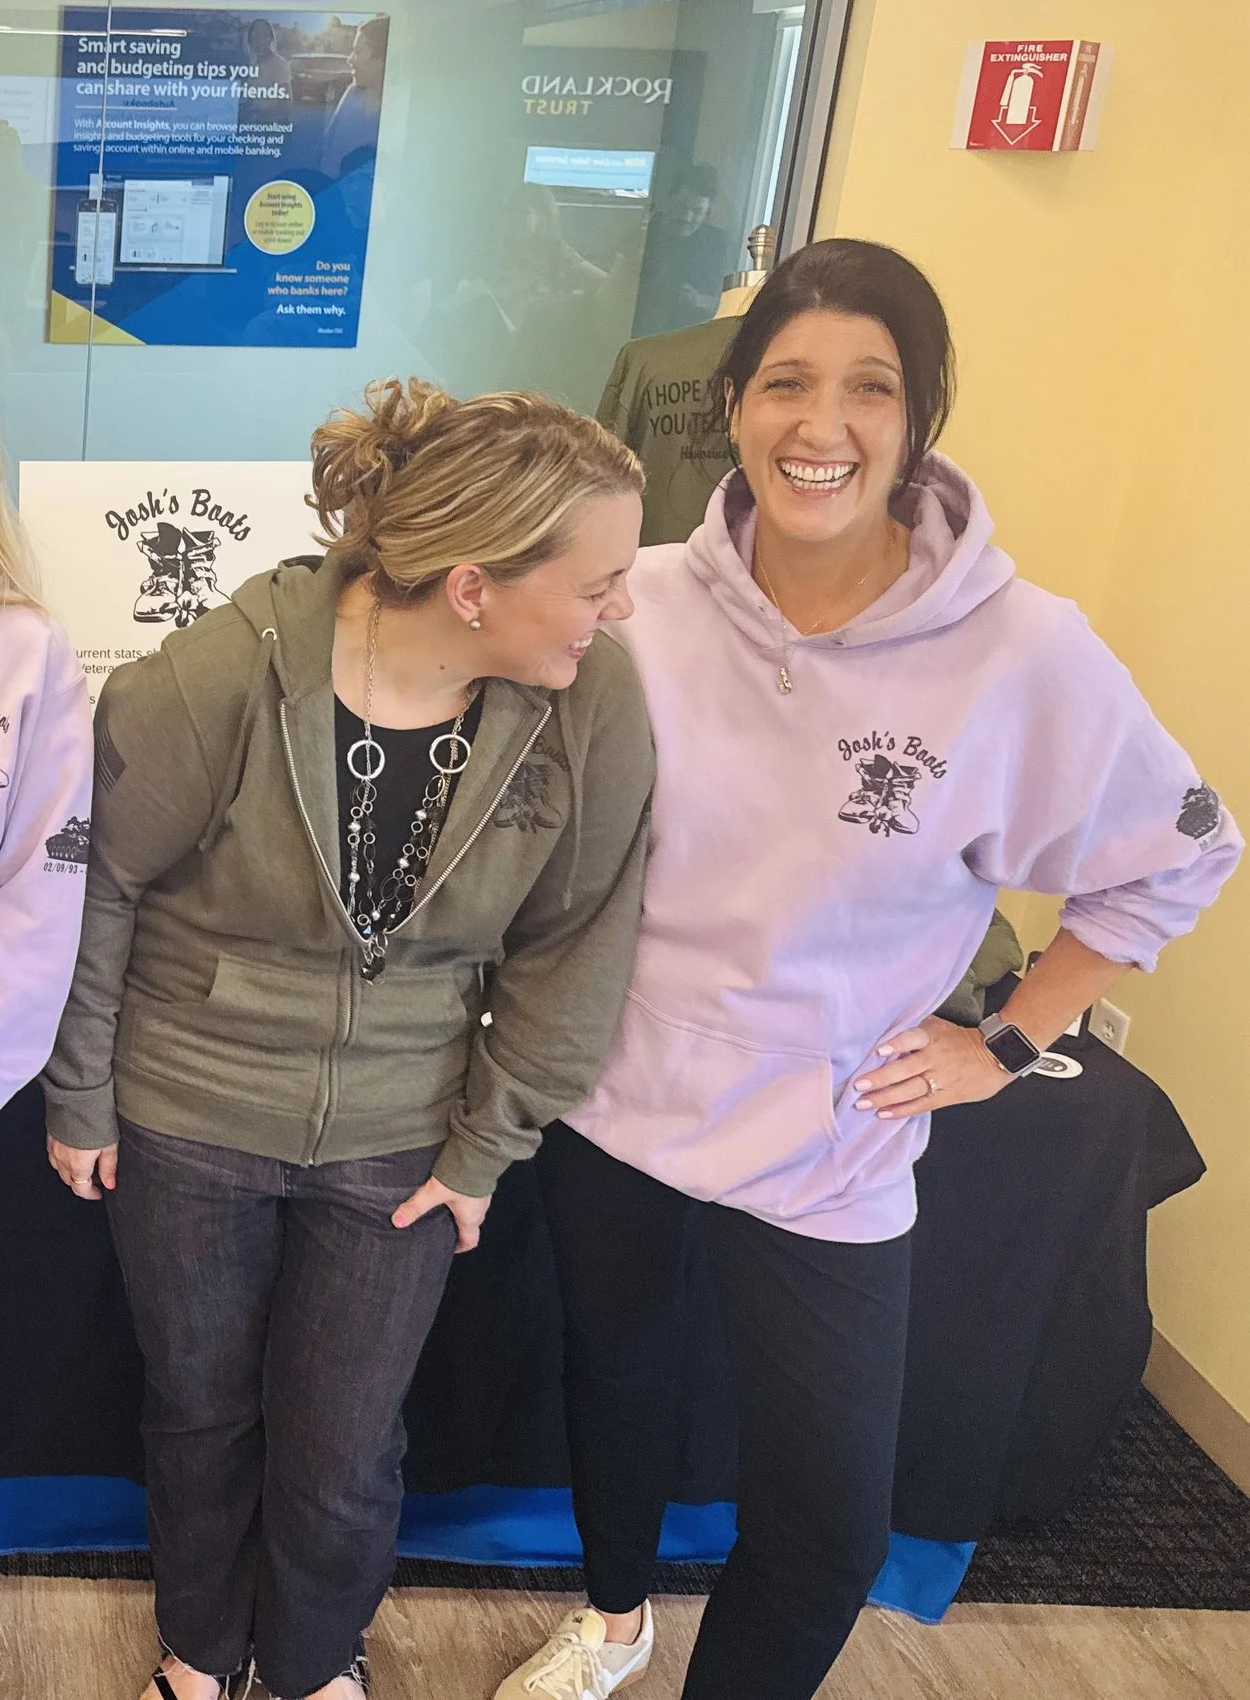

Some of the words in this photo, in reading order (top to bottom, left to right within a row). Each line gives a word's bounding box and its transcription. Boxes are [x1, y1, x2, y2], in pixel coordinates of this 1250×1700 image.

[78, 38, 127, 54] Smart
[130, 39, 181, 59] saving
[1016, 44, 1044, 53] FIRE
[990, 53, 1068, 62] EXTINGUISHER
[77, 59, 108, 74] and
[111, 59, 194, 80] budgeting
[198, 62, 226, 80] tips
[230, 65, 259, 81] you
[76, 82, 105, 95] can
[107, 80, 149, 96] share
[153, 81, 188, 97] with
[192, 84, 228, 100] your
[230, 82, 290, 99] friends.
[74, 118, 94, 128] With
[96, 119, 132, 129] Acount
[134, 120, 171, 131] Insights,
[172, 122, 188, 132] you
[190, 122, 205, 131] can
[206, 121, 238, 131] browse
[239, 122, 293, 133] personalized
[74, 130, 105, 141] insight
[107, 130, 124, 141] and
[126, 132, 170, 144] budgeting
[171, 132, 192, 142] tools
[193, 132, 205, 143] for
[206, 135, 226, 144] your
[227, 133, 266, 146] checking
[266, 134, 284, 144] and
[72, 144, 103, 154] saving
[104, 145, 140, 153] account
[141, 144, 167, 154] within
[168, 144, 195, 154] online
[196, 145, 213, 154] and
[214, 145, 244, 155] mobile
[245, 146, 282, 158] banking.
[316, 260, 330, 271] Do
[332, 263, 350, 273] you
[276, 272, 303, 282] know
[304, 275, 350, 284] someone
[268, 286, 289, 295] who
[290, 286, 319, 296] banks
[321, 286, 348, 296] here?
[276, 304, 295, 314] Ask
[296, 304, 322, 314] them
[323, 305, 346, 317] why.
[647, 388, 652, 409] I
[656, 380, 701, 406] HOPE
[650, 413, 685, 437] YOU
[105, 488, 180, 541] Josh's
[190, 488, 252, 541] Boots
[75, 649, 110, 658] urrent
[114, 649, 142, 658] stats
[82, 663, 117, 674] etera
[838, 731, 895, 761] Josh's
[903, 736, 947, 779] Boots
[44, 862, 78, 874] 02/09/93
